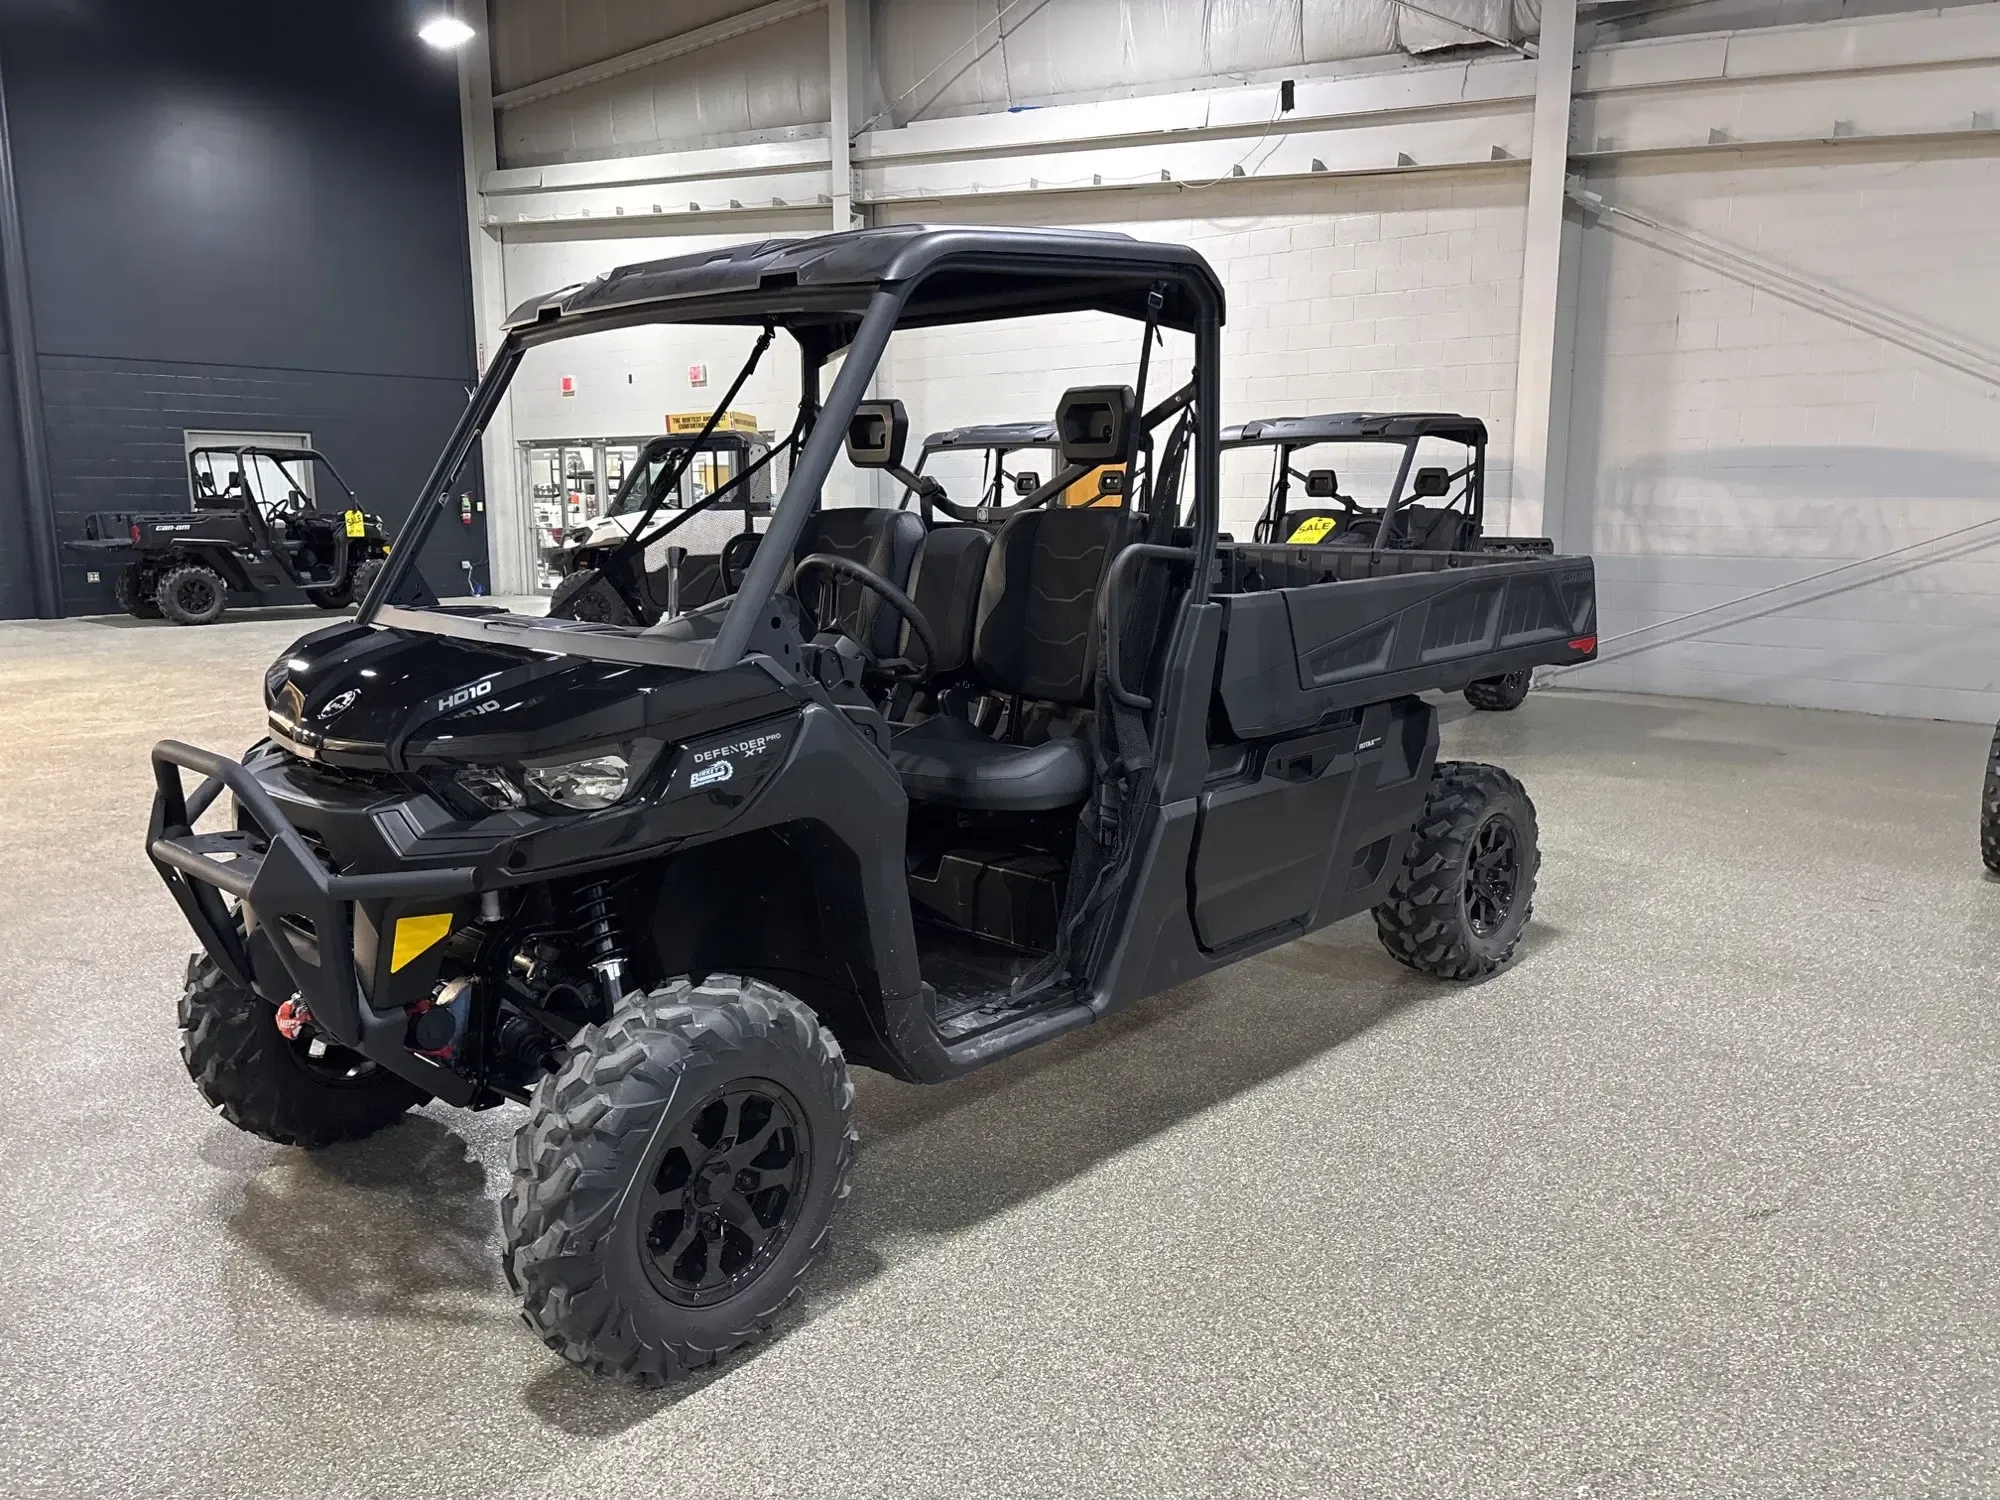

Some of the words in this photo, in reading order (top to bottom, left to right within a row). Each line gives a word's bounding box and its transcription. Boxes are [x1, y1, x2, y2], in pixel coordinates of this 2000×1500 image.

[1298, 522, 1331, 534] SALE
[438, 681, 492, 712] HD10
[693, 737, 766, 763] DEFENDER
[765, 733, 781, 742] PRO
[744, 746, 767, 758] XT
